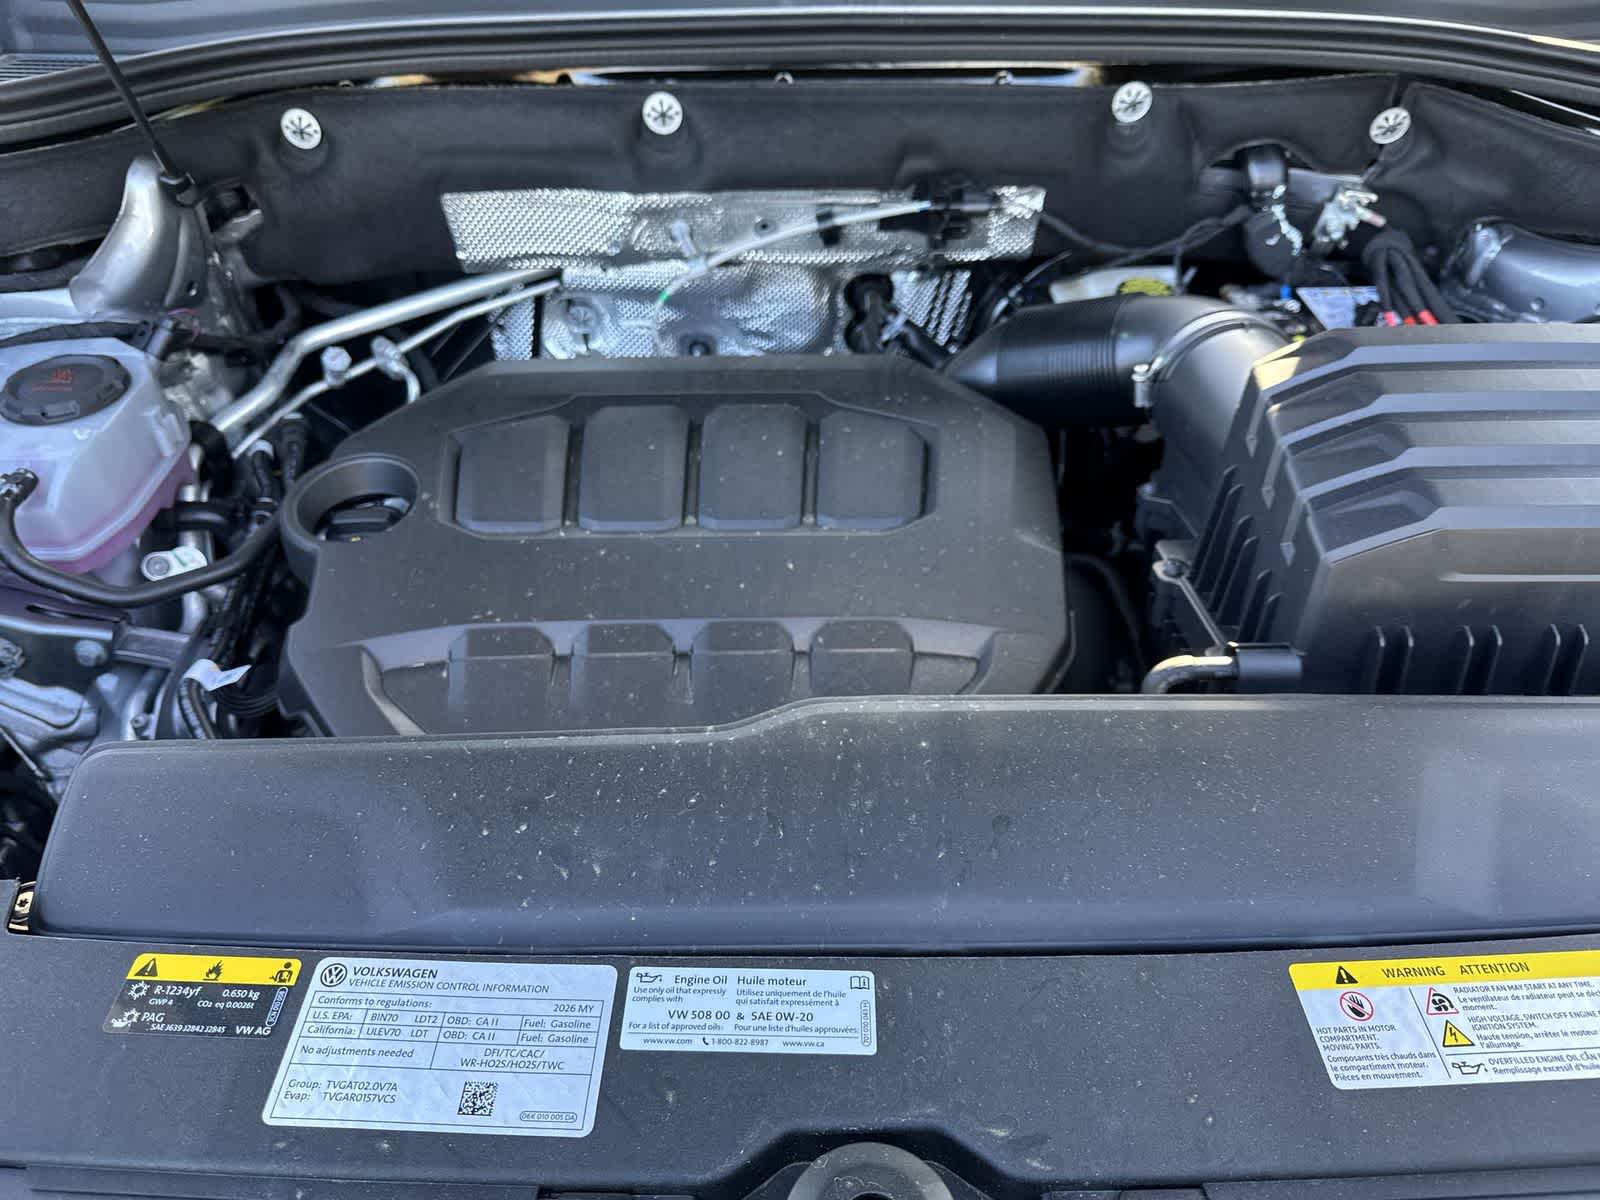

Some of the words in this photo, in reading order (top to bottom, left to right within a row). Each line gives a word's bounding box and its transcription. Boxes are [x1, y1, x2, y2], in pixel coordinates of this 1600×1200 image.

[353, 966, 438, 979] VOLKSWAGEN
[1382, 966, 1446, 980] WARNING
[1459, 962, 1530, 976] ATTENTION
[674, 975, 710, 986] Engine
[713, 976, 728, 984] Oil
[738, 976, 765, 985] Huile
[768, 977, 806, 986] moteur
[350, 979, 386, 988] VEHICLE
[388, 980, 434, 990] EMISSION
[436, 982, 480, 992] CONTROL
[482, 984, 550, 994] INFORMATION
[693, 988, 726, 996] expressly
[1453, 986, 1490, 994] RADIATOR
[1508, 984, 1523, 992] MAY
[1524, 983, 1548, 991] START
[1549, 982, 1557, 990] AT
[154, 986, 202, 1000] R-1234yf
[222, 988, 248, 998] 0.650
[249, 990, 260, 1000] kg
[766, 990, 811, 999] uniquement
[813, 990, 822, 998] de
[1470, 994, 1509, 1002] ventilateur
[1522, 992, 1557, 1000] radiateur
[1558, 991, 1575, 1000] peut
[318, 995, 362, 1006] Conforms
[365, 996, 373, 1006] to
[376, 998, 432, 1009] regulations:
[736, 998, 748, 1006] qui
[750, 998, 778, 1006] satisfait
[781, 999, 832, 1007] expressément
[553, 1004, 576, 1012] 2026
[578, 1005, 594, 1014] MY
[141, 1012, 165, 1023] PAG
[312, 1010, 330, 1020] U.S.
[332, 1011, 352, 1021] EPA:
[370, 1013, 398, 1022] BIN70
[414, 1015, 438, 1024] LDT2
[447, 1016, 472, 1026] OBD:
[476, 1017, 490, 1026] CA
[491, 1018, 498, 1026] II
[524, 1018, 546, 1028] Fuel:
[550, 1020, 591, 1030] Gasoline
[668, 1010, 688, 1020] VW
[691, 1010, 712, 1020] 508
[715, 1011, 730, 1020] 00
[736, 1012, 745, 1020] &
[752, 1012, 772, 1021] SAE
[776, 1012, 814, 1022] 0W-20
[1467, 1014, 1488, 1023] HIGH
[1488, 1013, 1523, 1023] VOLTAGE,
[1522, 1012, 1554, 1021] SWITCH
[1553, 1012, 1569, 1020] OFF
[1570, 1010, 1598, 1018] ENGINE
[150, 1024, 164, 1032] SAE
[165, 1024, 182, 1032] J639
[235, 1026, 253, 1035] VW
[254, 1026, 271, 1036] AG
[629, 1022, 640, 1030] For
[648, 1022, 660, 1030] list
[661, 1022, 670, 1030] of
[672, 1023, 706, 1031] approved
[734, 1024, 751, 1032] Pour
[1316, 1026, 1332, 1034] HOT
[1333, 1026, 1357, 1034] PARTS
[1368, 1024, 1396, 1032] MOTOR
[1472, 1023, 1506, 1032] IGNITION
[307, 1024, 356, 1036] California:
[366, 1028, 401, 1037] ULEV70
[410, 1029, 428, 1038] LDT
[443, 1030, 468, 1040] OBD:
[472, 1031, 486, 1040] CA
[488, 1032, 496, 1041] II
[520, 1032, 543, 1042] Fuel:
[548, 1034, 589, 1044] Gasoline
[1320, 1034, 1380, 1042] COMPARTMENT.
[1476, 1033, 1502, 1041] Haute
[1502, 1032, 1533, 1040] tension,
[1534, 1030, 1562, 1038] arrêter
[712, 1038, 768, 1046] 1-800-822-8987
[782, 1040, 824, 1048] www.vw.ca
[1323, 1042, 1354, 1051] MOVING
[300, 1045, 314, 1054] No
[316, 1046, 376, 1056] adjustments
[378, 1048, 414, 1058] needed
[484, 1048, 545, 1058] DFI/TC/CAC/
[1327, 1054, 1374, 1063] Composants
[1390, 1052, 1417, 1060] chauds
[1488, 1056, 1536, 1066] OVERFILLED
[1536, 1055, 1566, 1064] ENGINE
[1566, 1054, 1578, 1062] OIL
[460, 1058, 566, 1070] WR-HO2S/HO2S/TWC
[1330, 1064, 1338, 1072] le
[1340, 1062, 1396, 1072] compartiment
[1397, 1062, 1428, 1070] moteur.
[1492, 1066, 1542, 1076] Remplissage
[1542, 1064, 1574, 1072] excessif
[1334, 1072, 1360, 1080] Pièces
[288, 1079, 322, 1090] Group:
[326, 1080, 398, 1092] TVGAT02.0V7A
[284, 1090, 311, 1101] Evap:
[323, 1092, 396, 1104] TVGAR0157VCS
